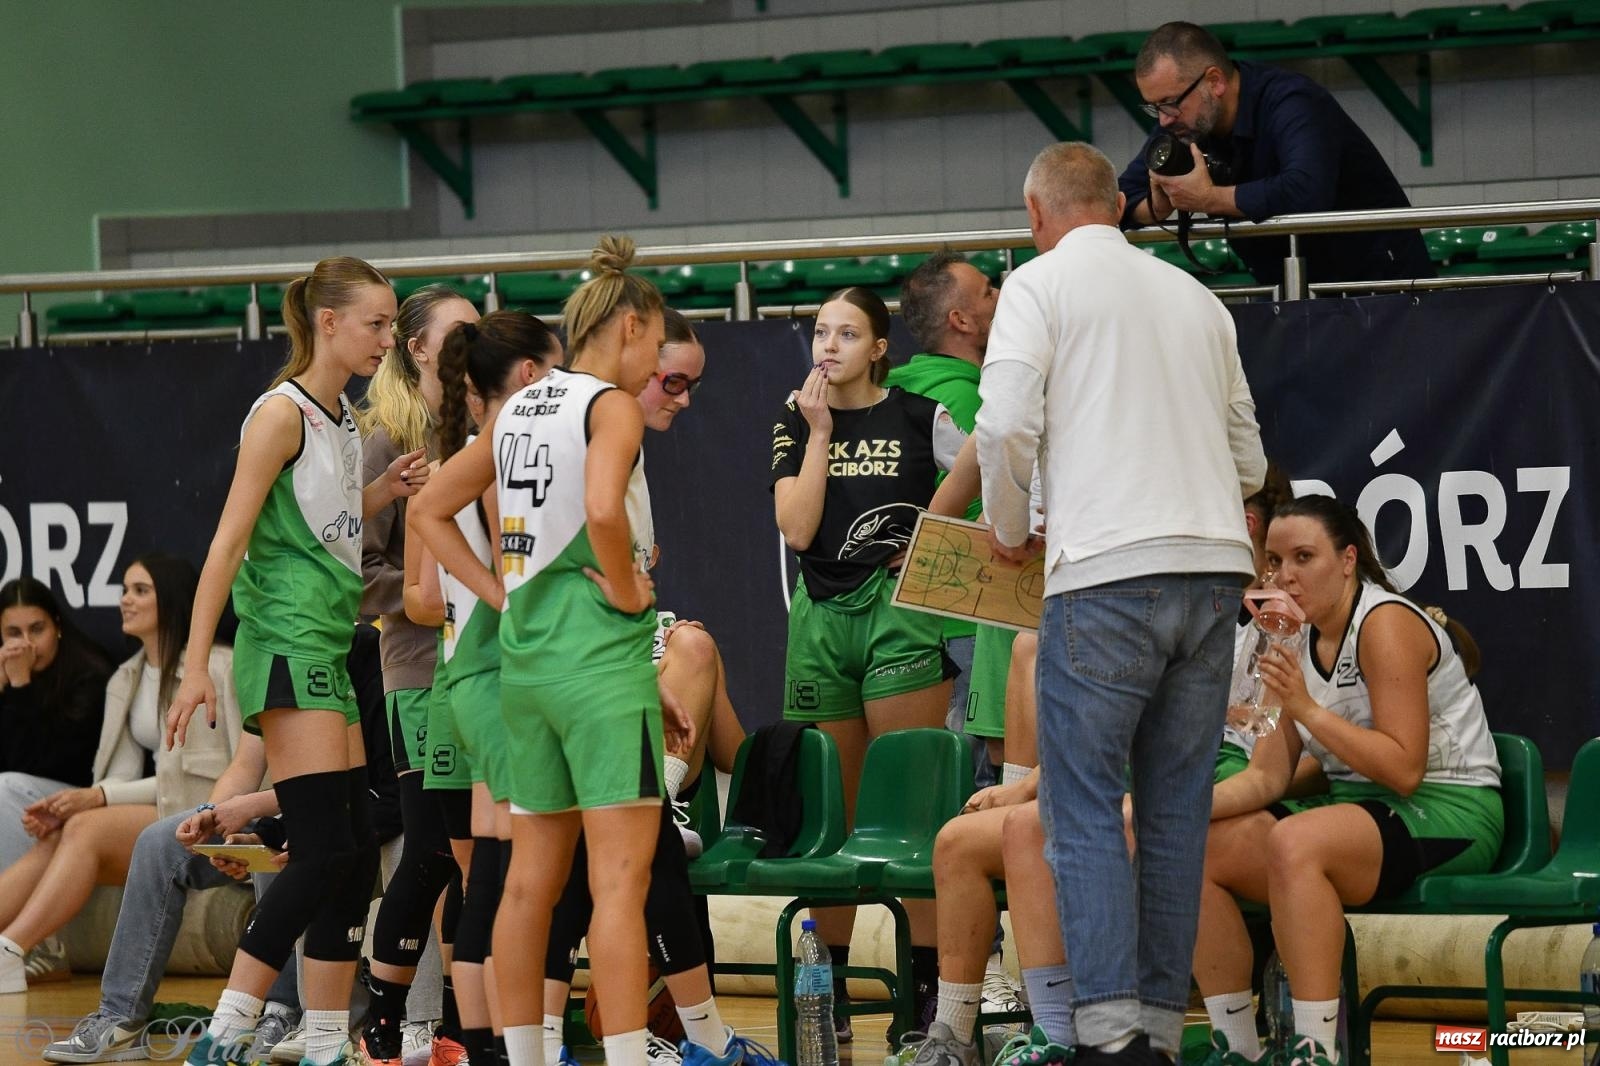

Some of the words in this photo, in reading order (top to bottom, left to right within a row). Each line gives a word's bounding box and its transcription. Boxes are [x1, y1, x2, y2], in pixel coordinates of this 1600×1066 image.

[854, 439, 901, 458] AZS
[827, 457, 899, 477] CIBÓRZ
[789, 680, 821, 710] 13
[431, 744, 456, 776] 3
